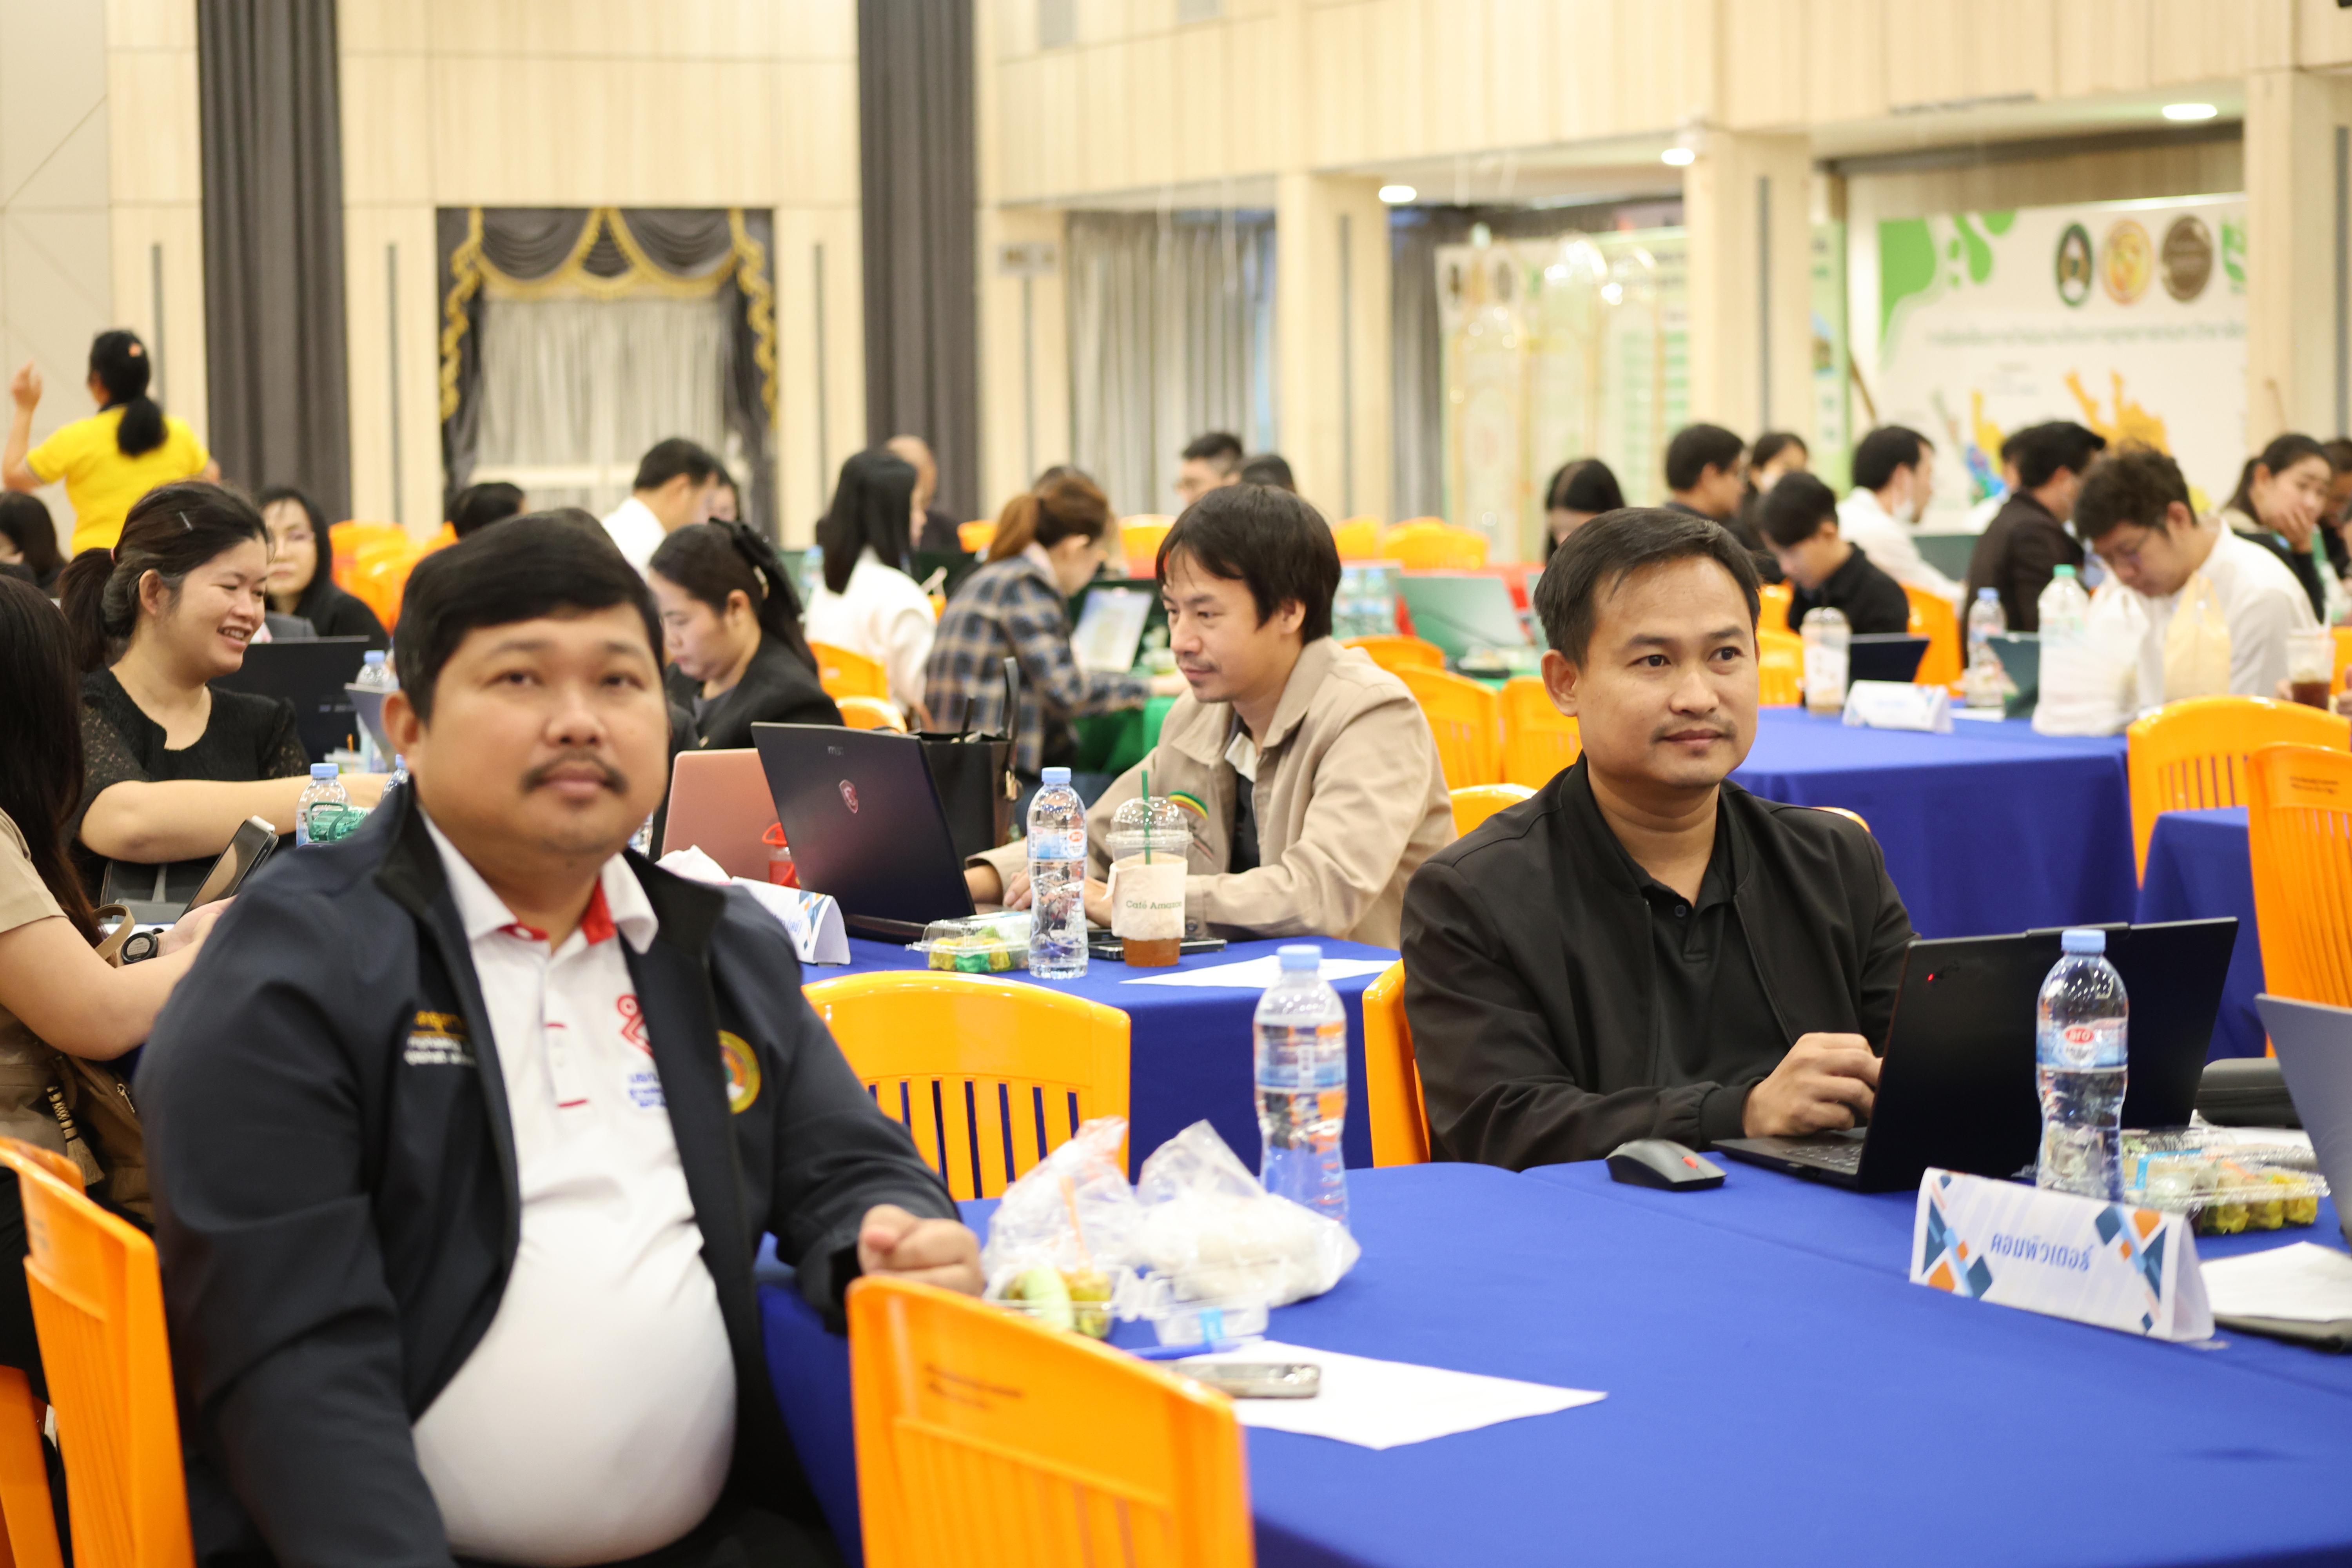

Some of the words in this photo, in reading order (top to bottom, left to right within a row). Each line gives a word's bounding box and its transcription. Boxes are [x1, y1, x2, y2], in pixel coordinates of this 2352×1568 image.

[1126, 900, 1147, 909] Café
[1990, 1233, 2094, 1272] คอมพิวเตอร์
